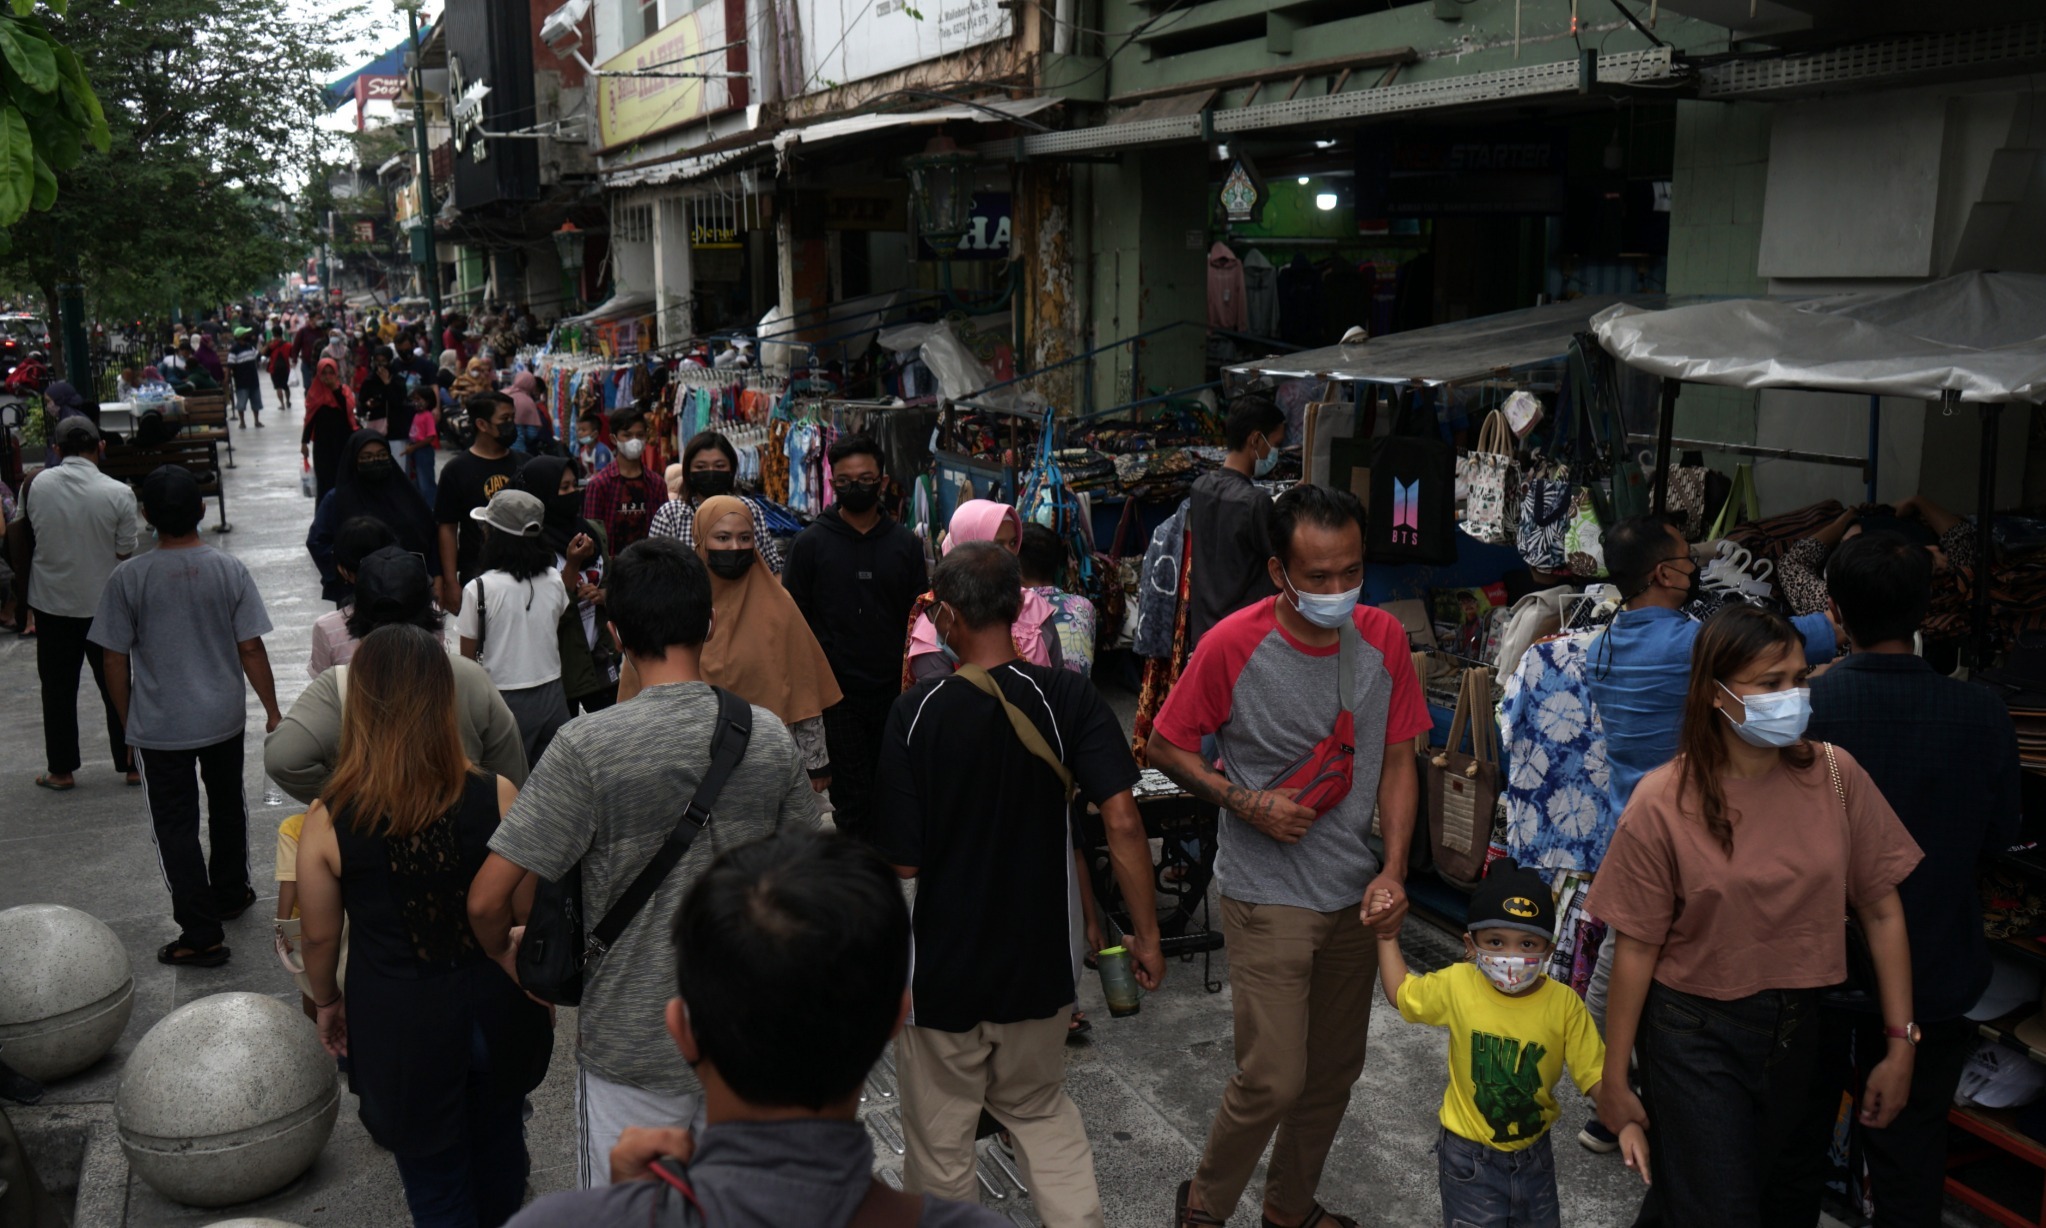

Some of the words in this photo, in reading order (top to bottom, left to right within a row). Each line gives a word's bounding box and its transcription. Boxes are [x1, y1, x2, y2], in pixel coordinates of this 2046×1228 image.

[1450, 143, 1549, 169] STARTER
[1391, 530, 1418, 546] BTS
[1471, 1029, 1547, 1093] HULK
